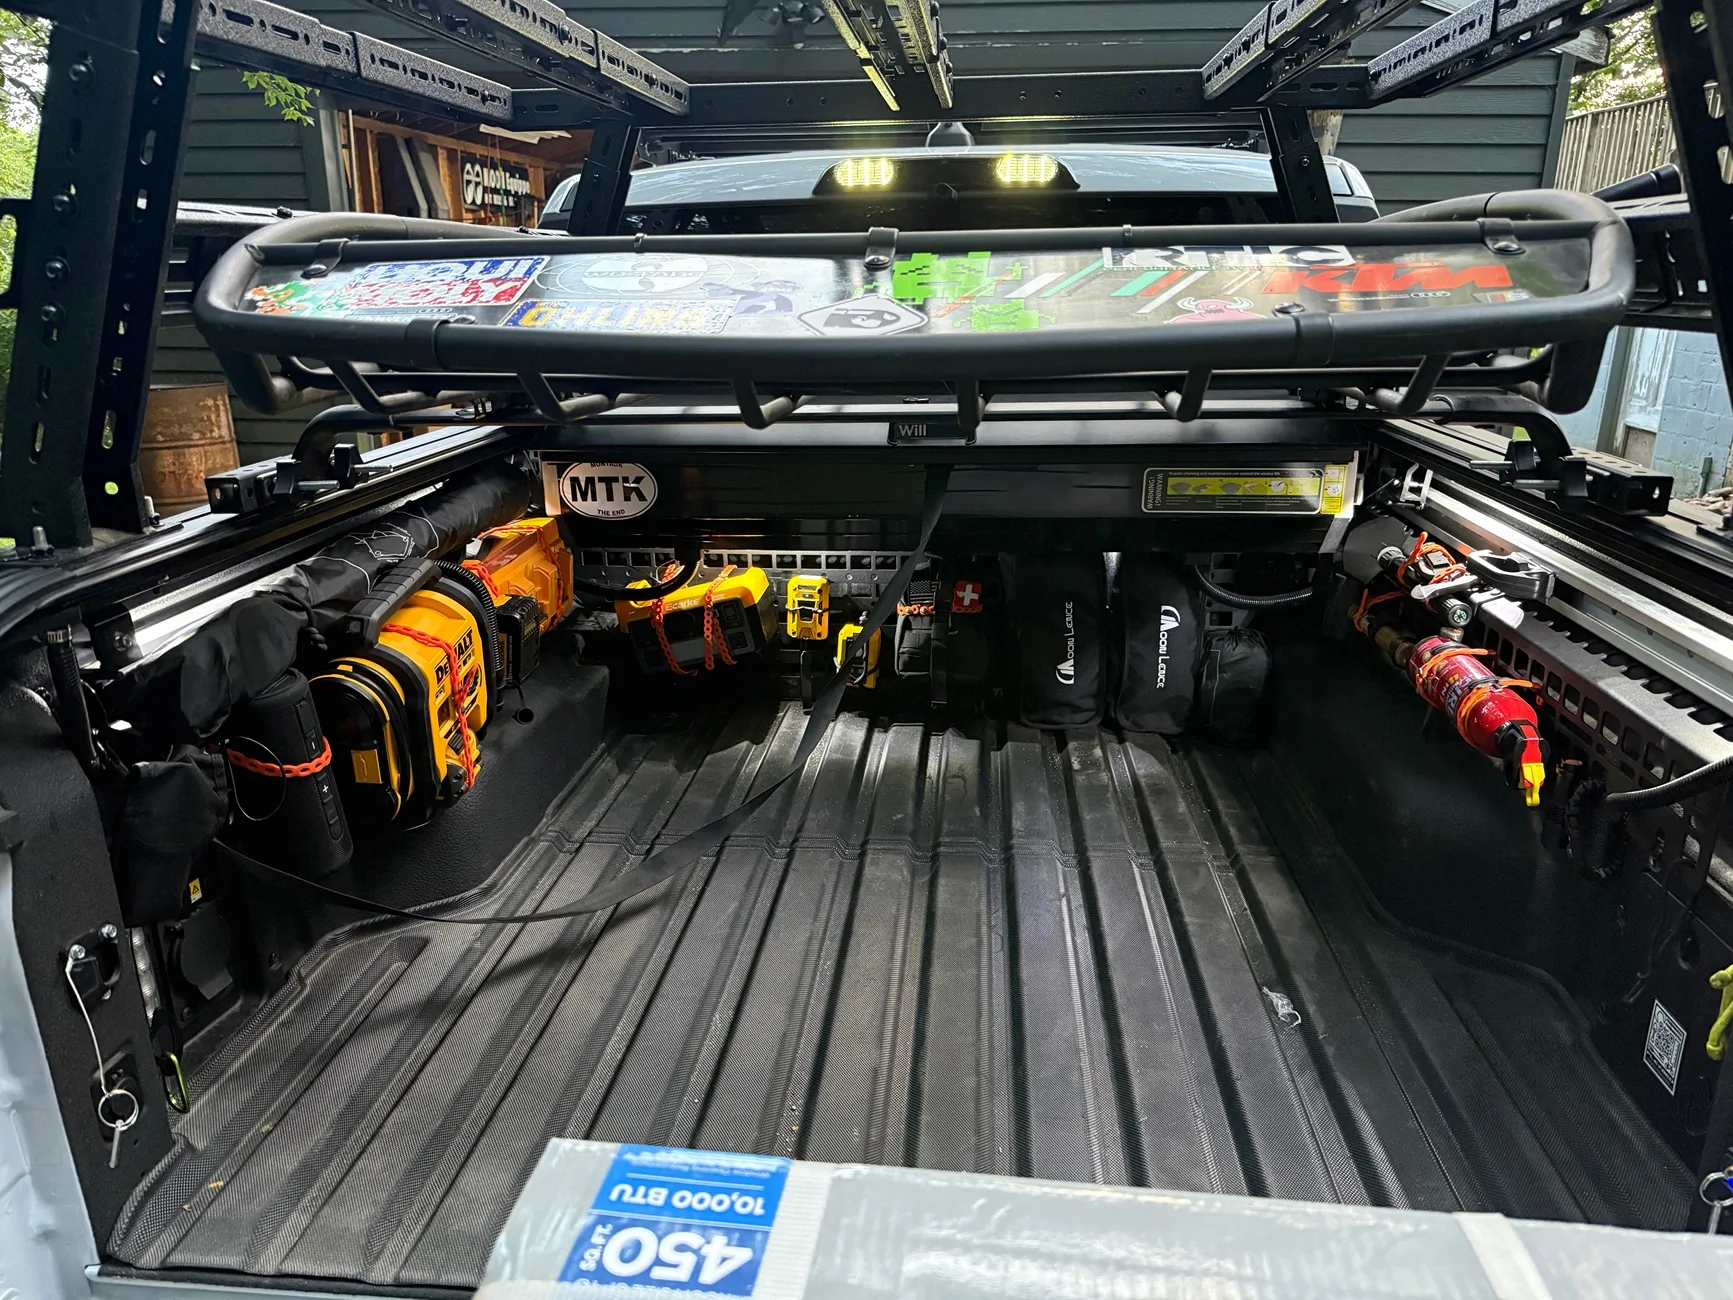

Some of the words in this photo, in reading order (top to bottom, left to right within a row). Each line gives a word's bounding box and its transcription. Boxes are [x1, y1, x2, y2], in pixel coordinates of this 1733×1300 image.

[1260, 262, 1513, 294] KTM
[899, 424, 927, 436] Will
[569, 476, 648, 502] MTK
[1155, 473, 1164, 506] WARNING!
[435, 628, 473, 685] DEALT
[609, 1183, 666, 1208] BTU
[672, 1189, 766, 1216] 10,000
[601, 1226, 754, 1285] 450
